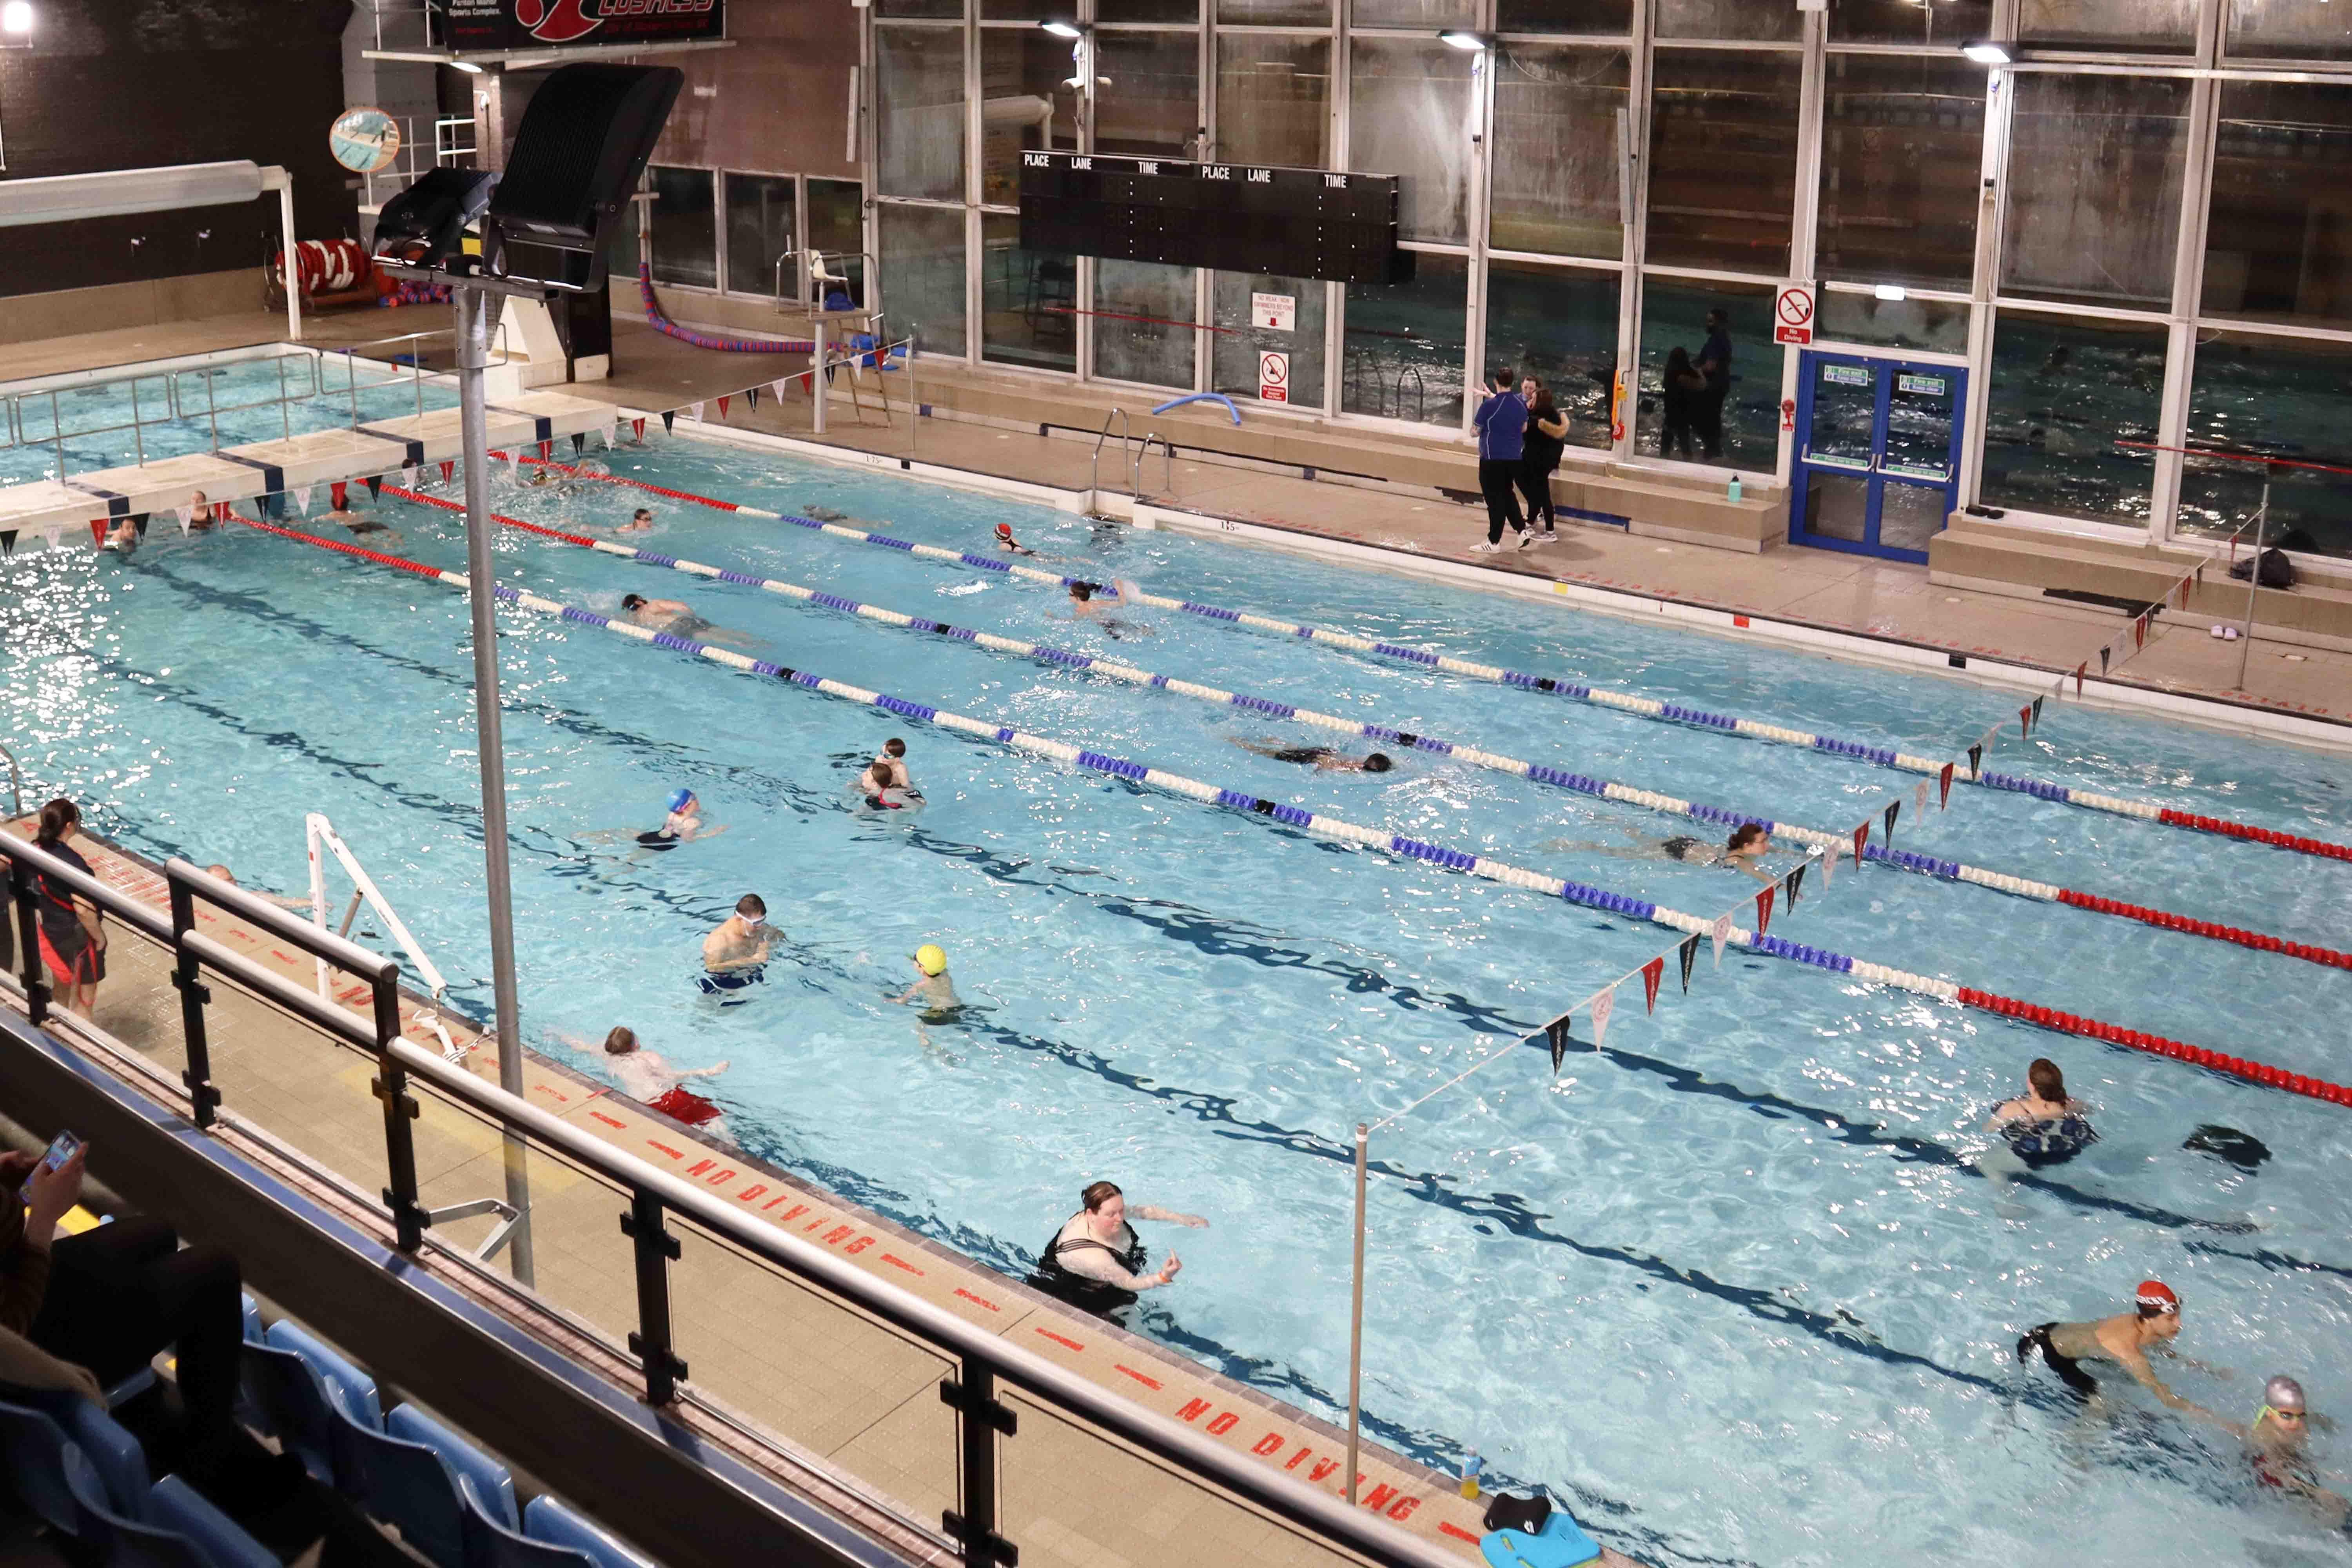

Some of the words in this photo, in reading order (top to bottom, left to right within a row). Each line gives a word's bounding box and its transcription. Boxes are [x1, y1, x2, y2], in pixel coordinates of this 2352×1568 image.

[449, 8, 472, 17] Sports
[1025, 154, 1049, 167] PLACE
[1071, 157, 1092, 170] LANE
[1138, 162, 1158, 174] TIME
[1202, 166, 1230, 180] PLACE
[1248, 169, 1270, 183] LANE
[1325, 174, 1347, 188] TIME
[685, 1159, 737, 1185] NO
[737, 1184, 876, 1254] DIVING
[1175, 1397, 1240, 1436] NO
[1250, 1432, 1421, 1521] DIVING
